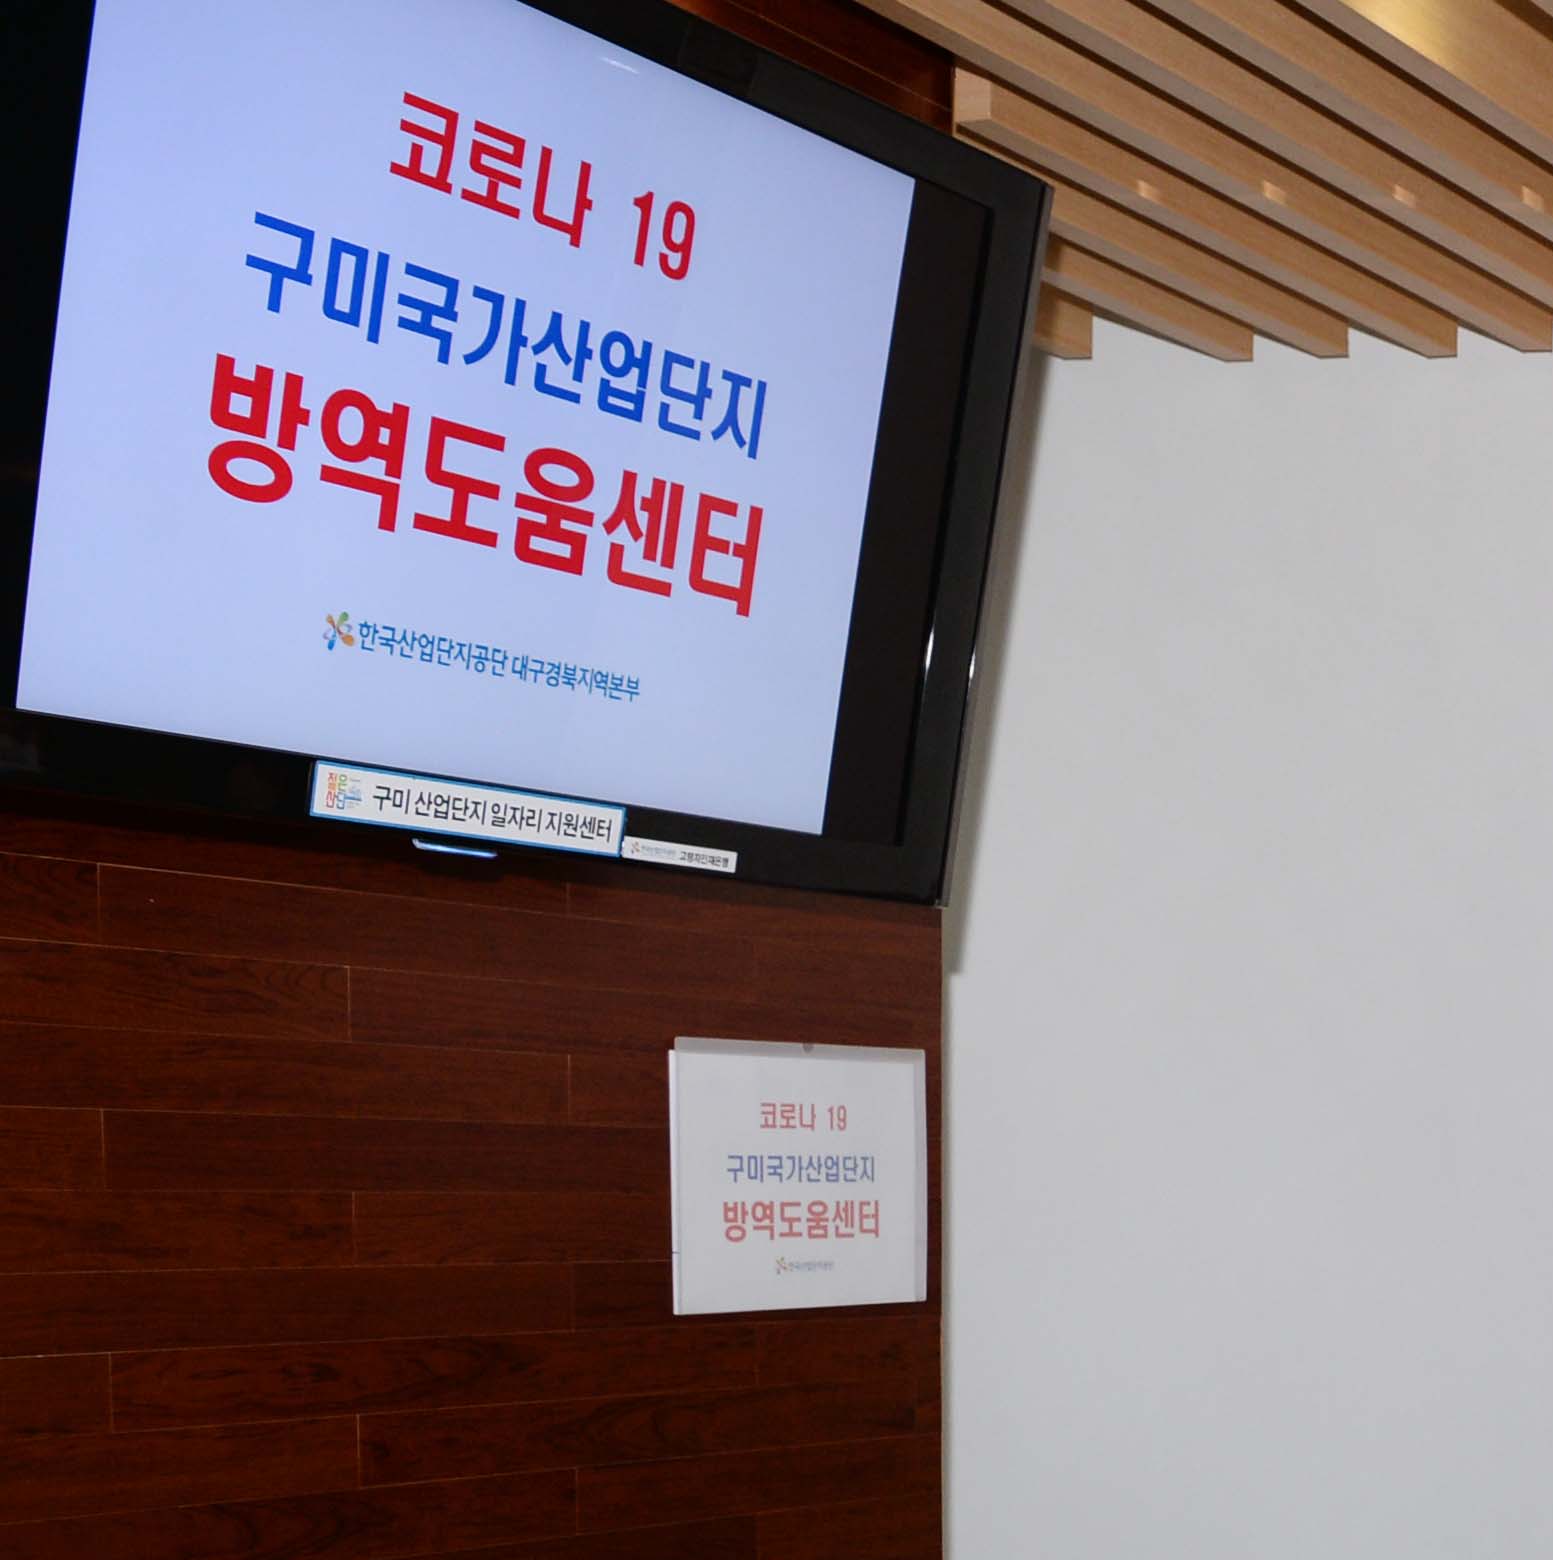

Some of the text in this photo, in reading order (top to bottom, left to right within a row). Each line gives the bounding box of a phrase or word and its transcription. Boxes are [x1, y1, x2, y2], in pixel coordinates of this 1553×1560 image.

[389, 89, 696, 281] 코로나 19
[244, 209, 770, 460] 구미국가산업단지
[207, 354, 763, 617] 방역도움센터
[358, 620, 641, 702] 한국산업단지공단 대구경북지역본부
[373, 786, 612, 843] 구미 산업단지 일자리 지원센터
[760, 1102, 847, 1131] 코로나 19
[726, 1155, 876, 1183] 구미국가산업단지
[722, 1200, 880, 1243] 방역도움센터
